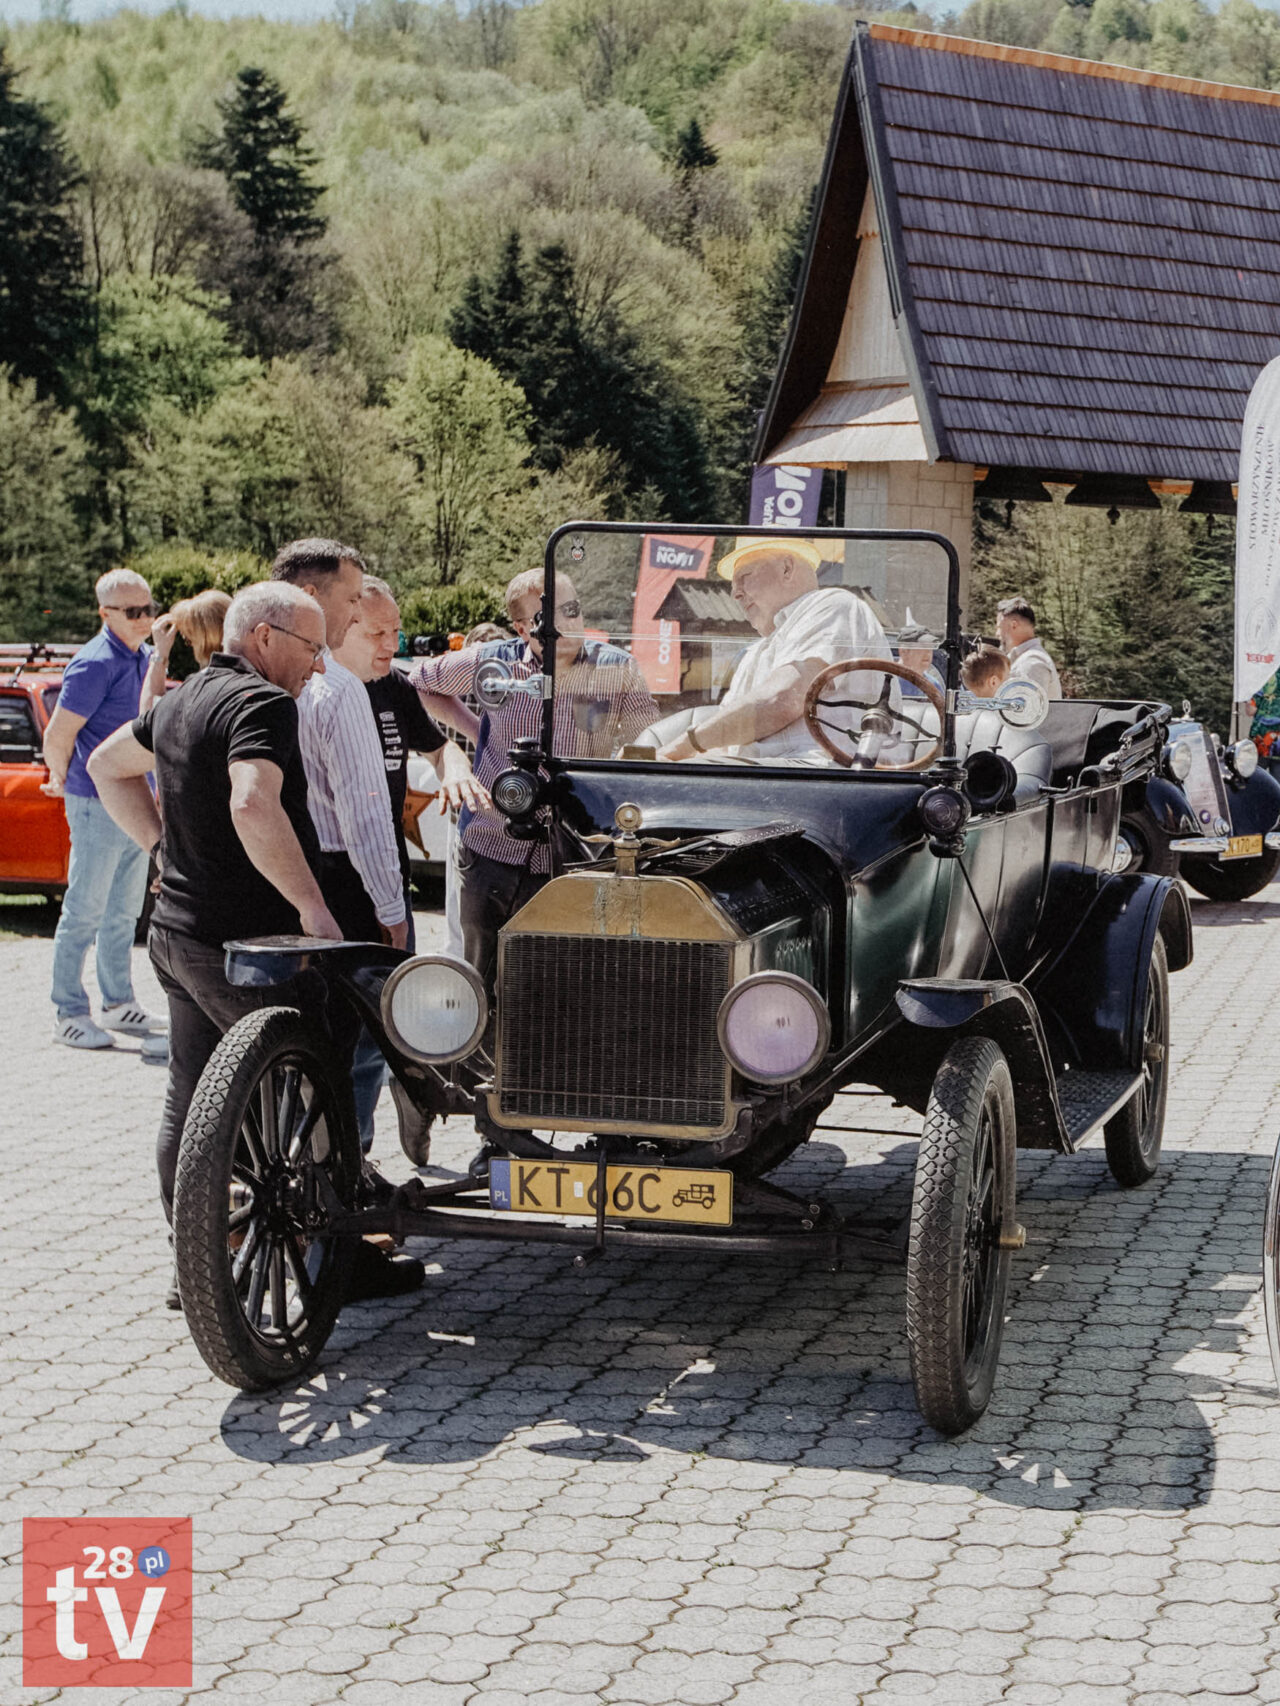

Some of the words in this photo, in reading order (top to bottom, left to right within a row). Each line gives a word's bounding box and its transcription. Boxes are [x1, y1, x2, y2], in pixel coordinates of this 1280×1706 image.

[494, 1190, 509, 1202] PL
[518, 1165, 570, 1208] KT
[587, 1171, 662, 1213] 66C
